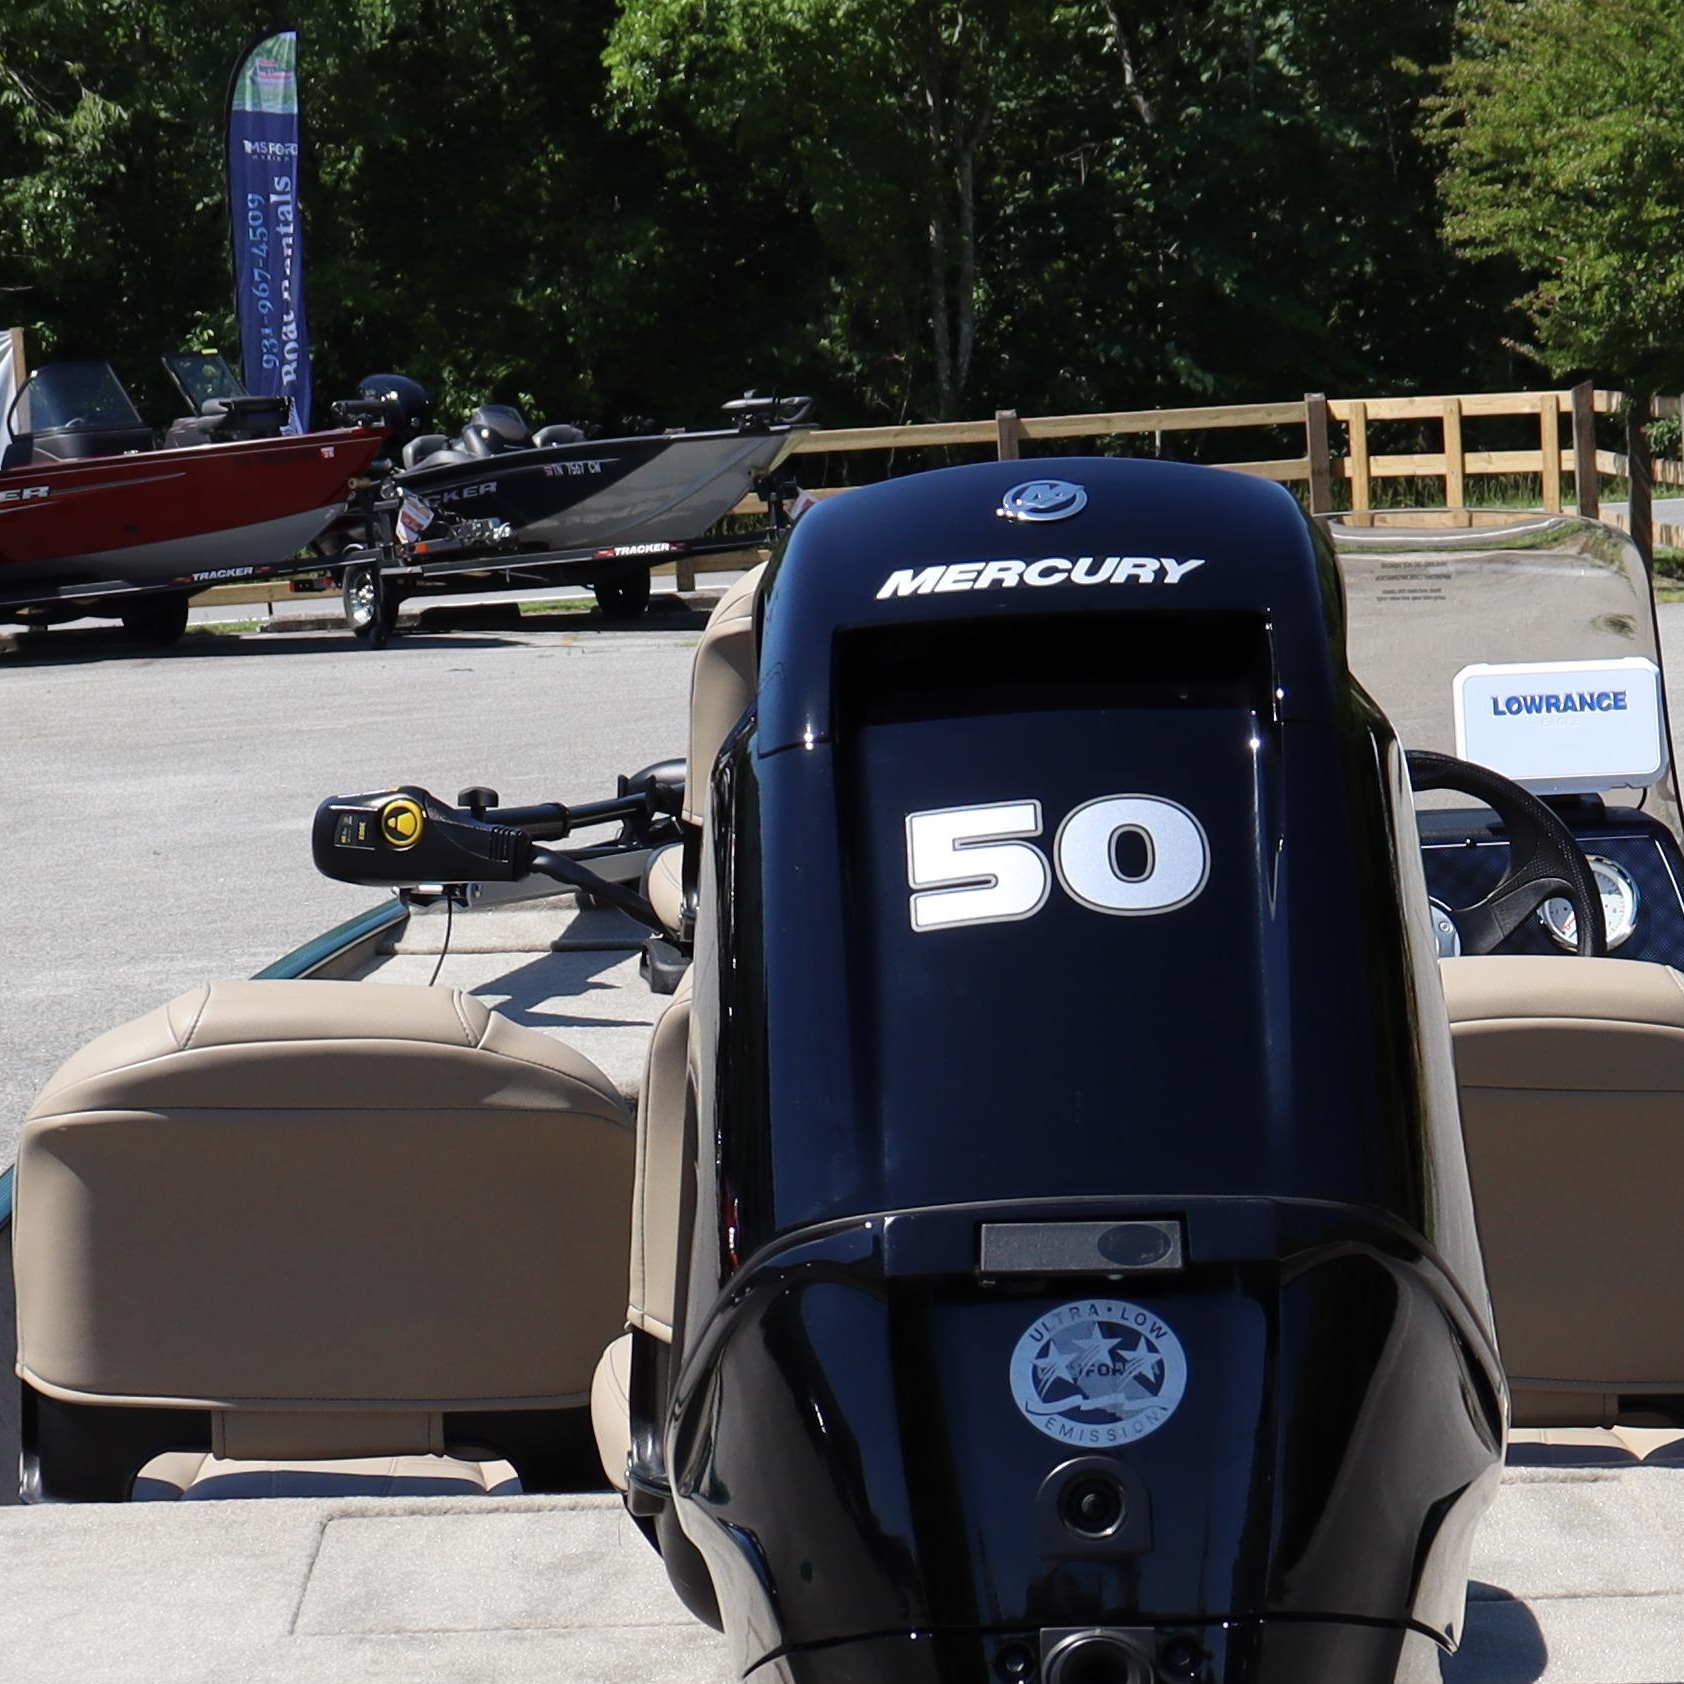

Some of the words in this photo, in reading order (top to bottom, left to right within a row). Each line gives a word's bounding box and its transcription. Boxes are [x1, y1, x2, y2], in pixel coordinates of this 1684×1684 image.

[247, 193, 279, 370] 931-967-4509
[613, 543, 671, 556] TRACKER
[191, 566, 254, 581] TRACKER
[875, 556, 1206, 600] MERCURY
[1491, 689, 1629, 717] LOWRANCE
[904, 792, 1212, 934] 50
[1029, 1304, 1100, 1343] ULTRA
[1120, 1307, 1168, 1340] LOW
[1044, 1411, 1163, 1443] EMISSION
